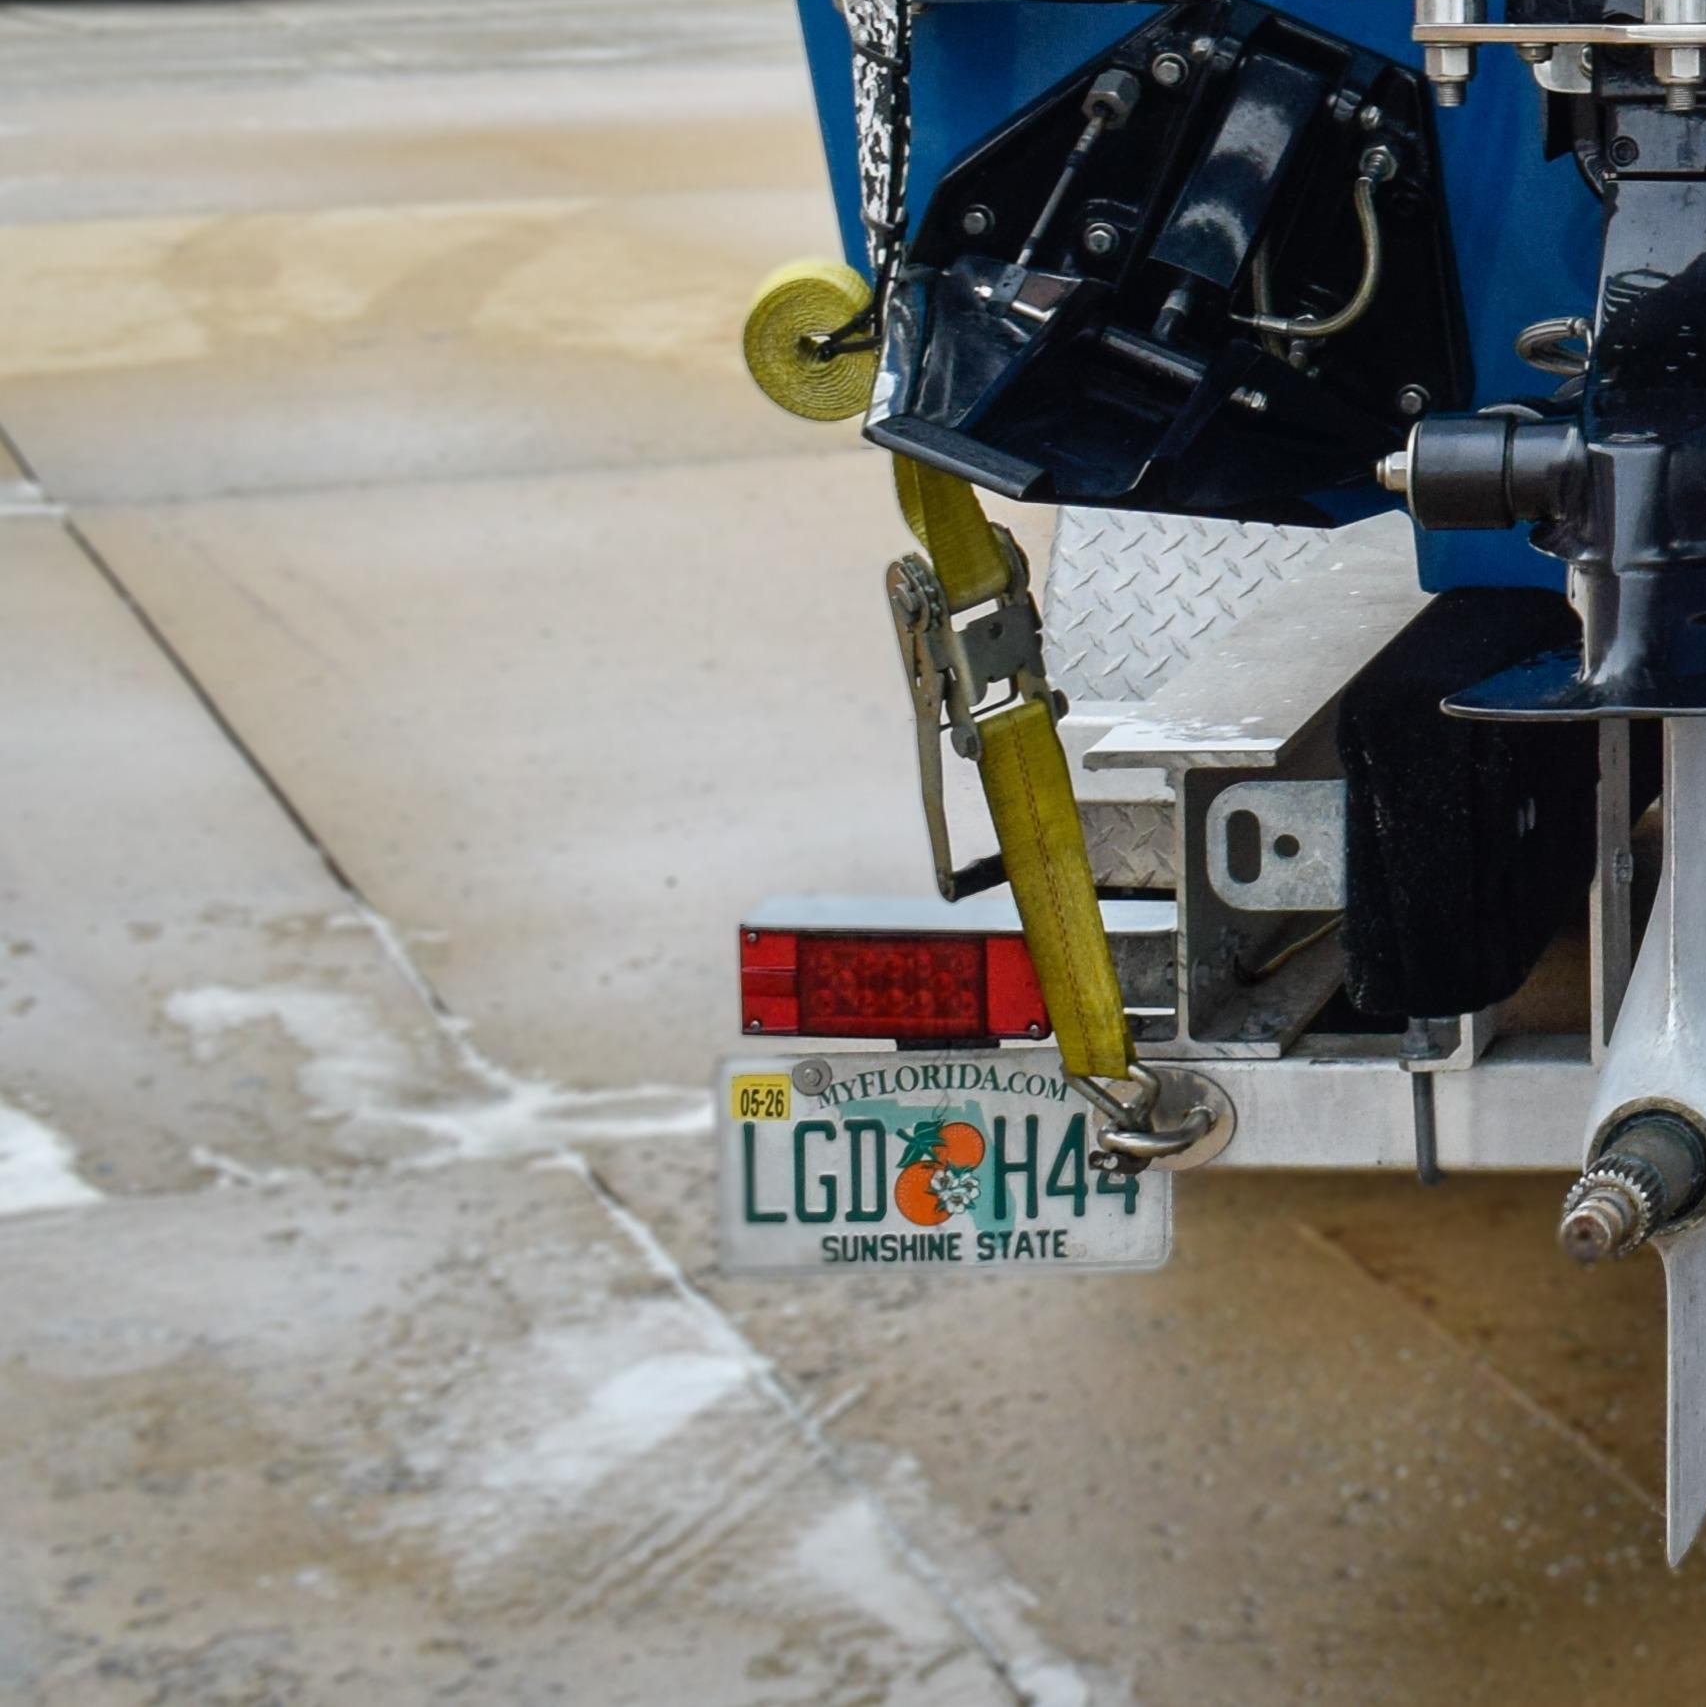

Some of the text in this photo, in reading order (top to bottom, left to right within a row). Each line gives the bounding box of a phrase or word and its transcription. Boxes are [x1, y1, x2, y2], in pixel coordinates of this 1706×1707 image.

[740, 1088, 784, 1117] 05-26
[743, 1118, 886, 1222] LGD
[822, 1229, 1069, 1263] SUNSHINE STATE
